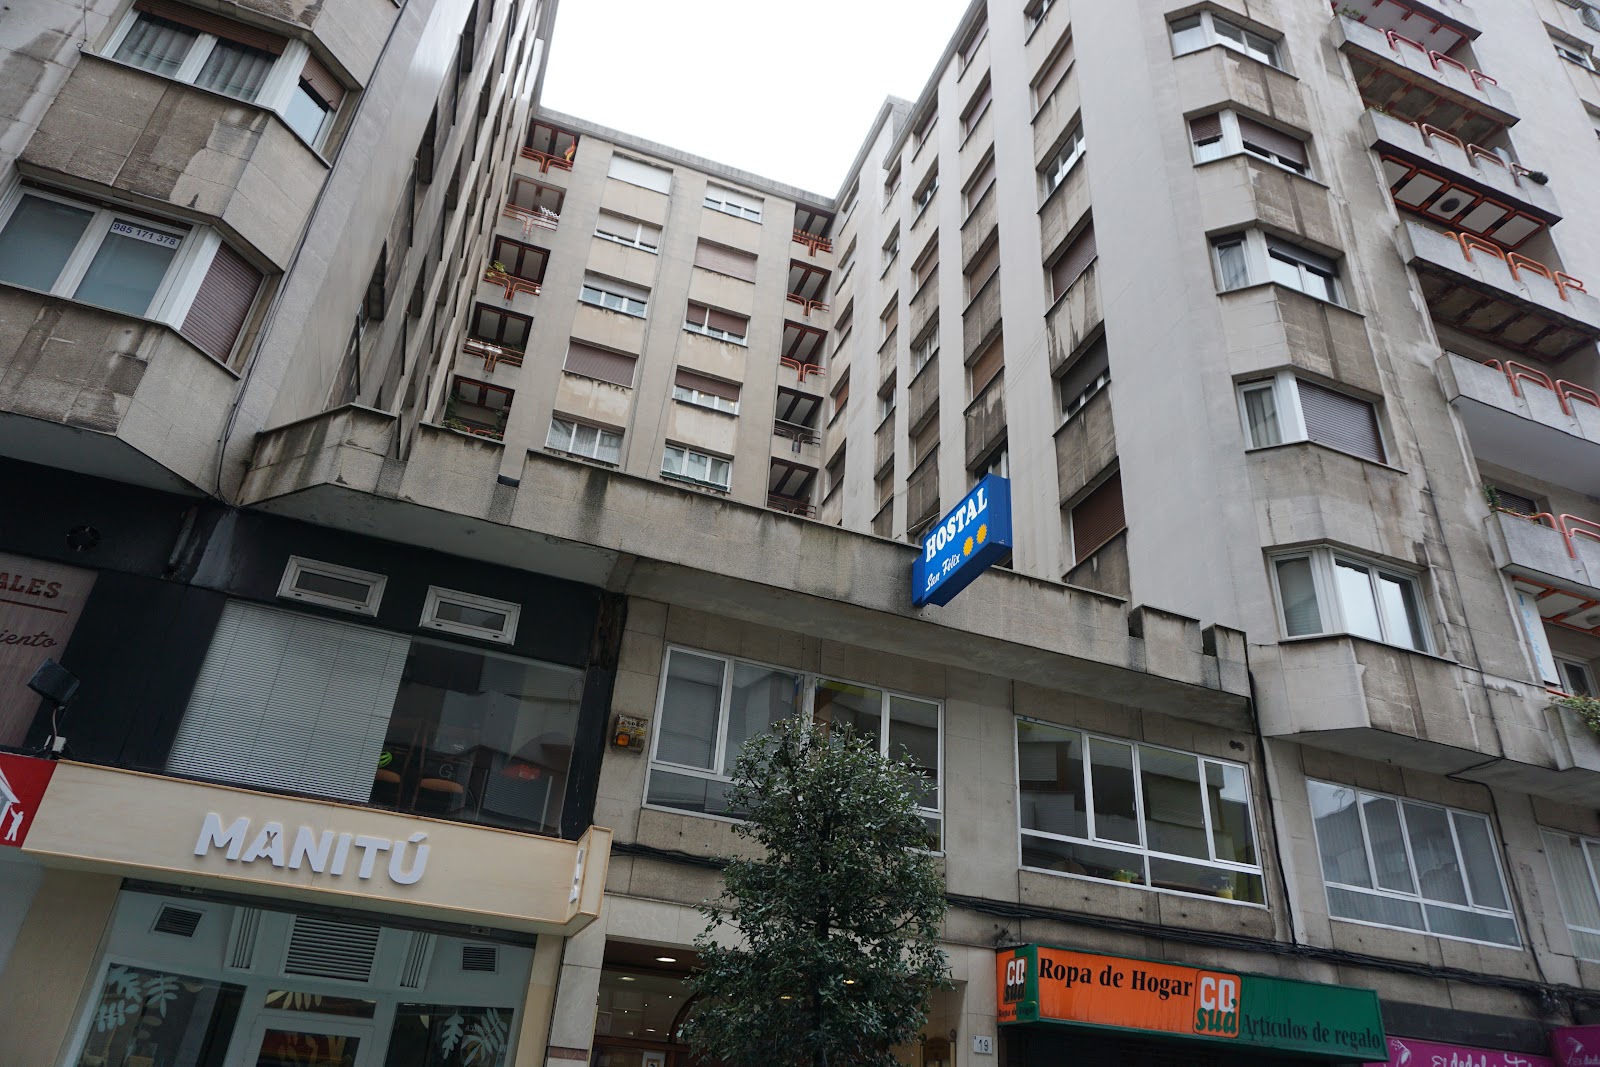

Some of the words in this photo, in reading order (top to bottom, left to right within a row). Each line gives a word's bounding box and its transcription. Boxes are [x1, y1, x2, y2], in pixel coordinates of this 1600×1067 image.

[113, 223, 133, 234] 985
[136, 229, 154, 240] 171
[156, 234, 177, 246] 378
[925, 487, 988, 563] HOSTAL
[925, 572, 940, 592] San
[193, 812, 431, 885] MANITÚ
[1039, 958, 1092, 988] Ropa
[1099, 965, 1124, 988] de
[1131, 970, 1193, 1001] Hogar
[978, 1039, 989, 1051] 19
[1243, 1014, 1308, 1041] Artículos
[1313, 1021, 1330, 1043] de
[1335, 1027, 1381, 1051] regalo
